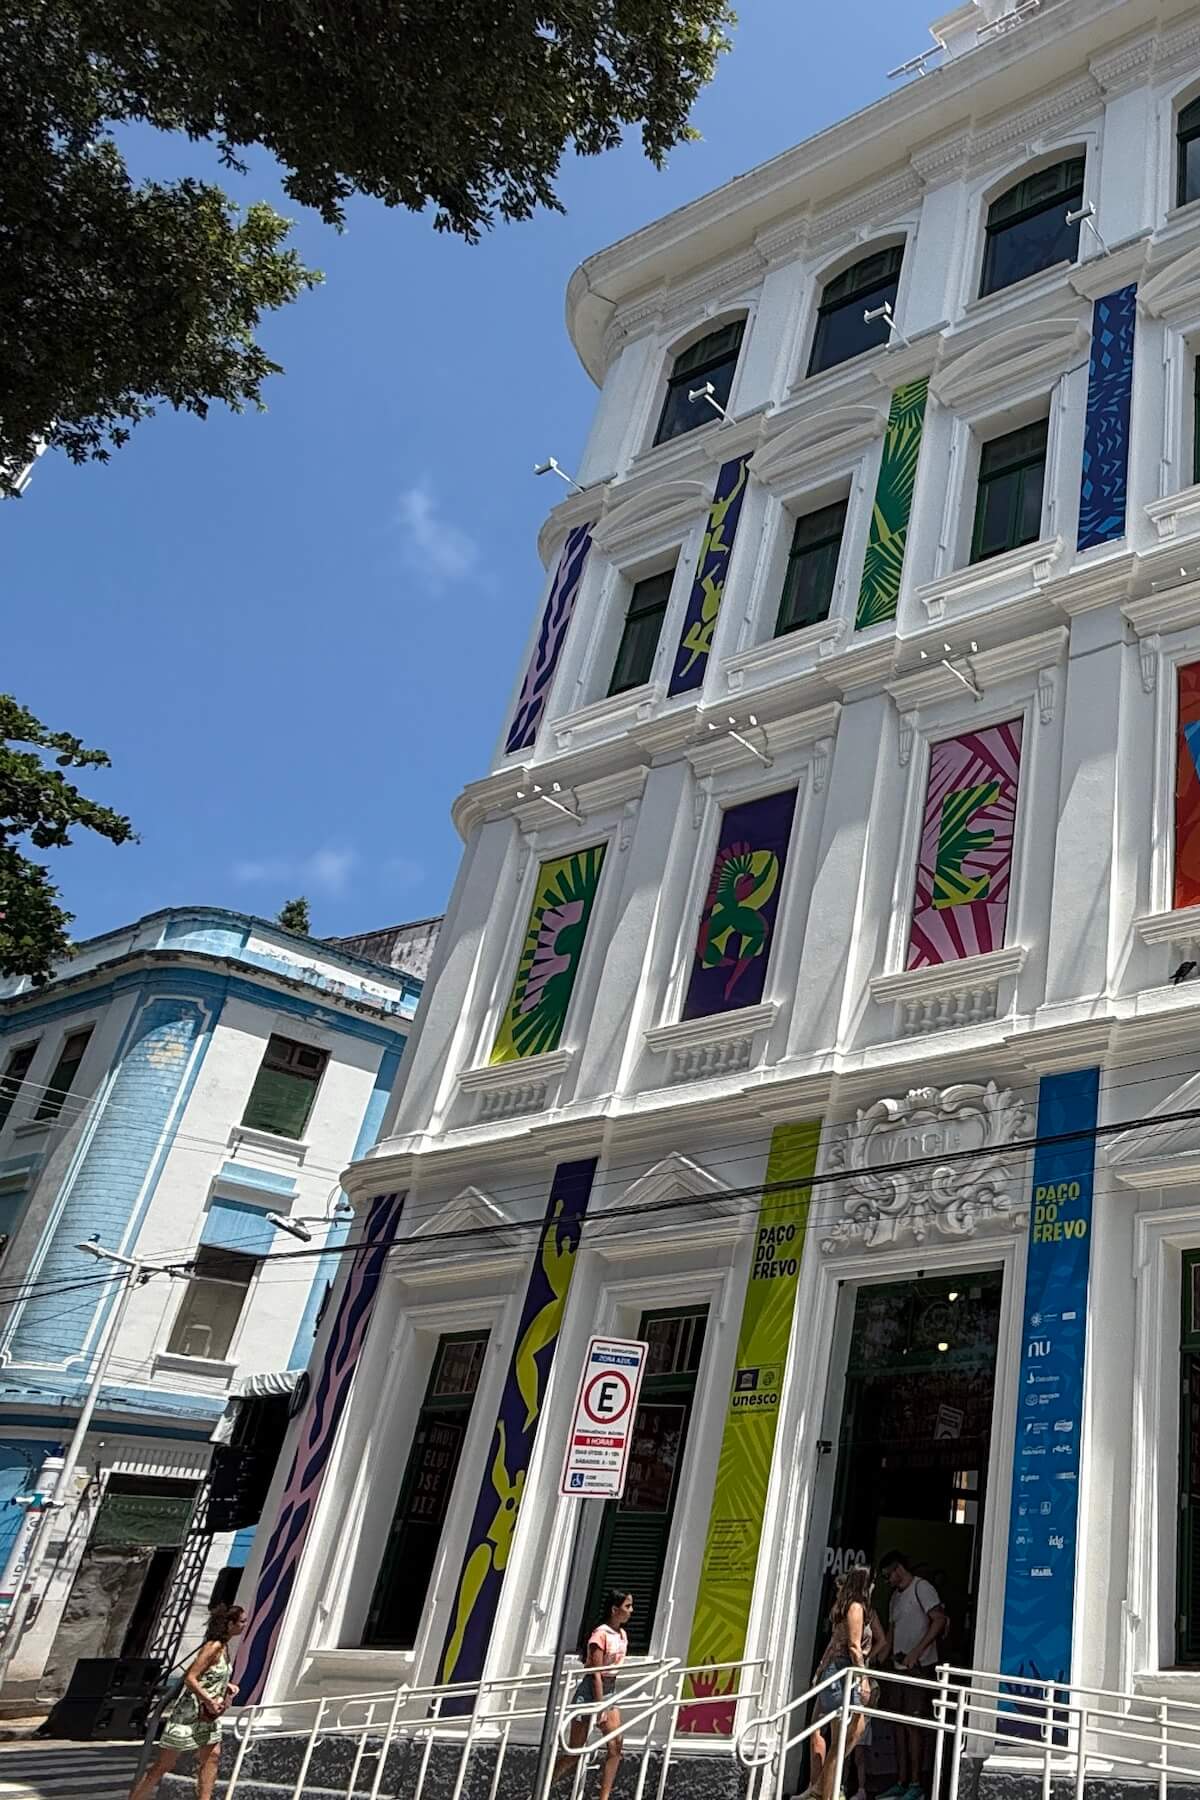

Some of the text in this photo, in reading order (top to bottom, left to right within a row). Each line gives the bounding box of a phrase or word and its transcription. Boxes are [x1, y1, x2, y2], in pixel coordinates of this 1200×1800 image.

[1036, 1182, 1080, 1206] PAÇO
[1034, 1204, 1058, 1224] DO
[759, 1224, 796, 1245] PAÇO
[1033, 1219, 1087, 1244] FREVO
[756, 1244, 775, 1262] DO
[752, 1259, 797, 1280] FREVO
[597, 1382, 618, 1413] E
[732, 1393, 777, 1407] unesco
